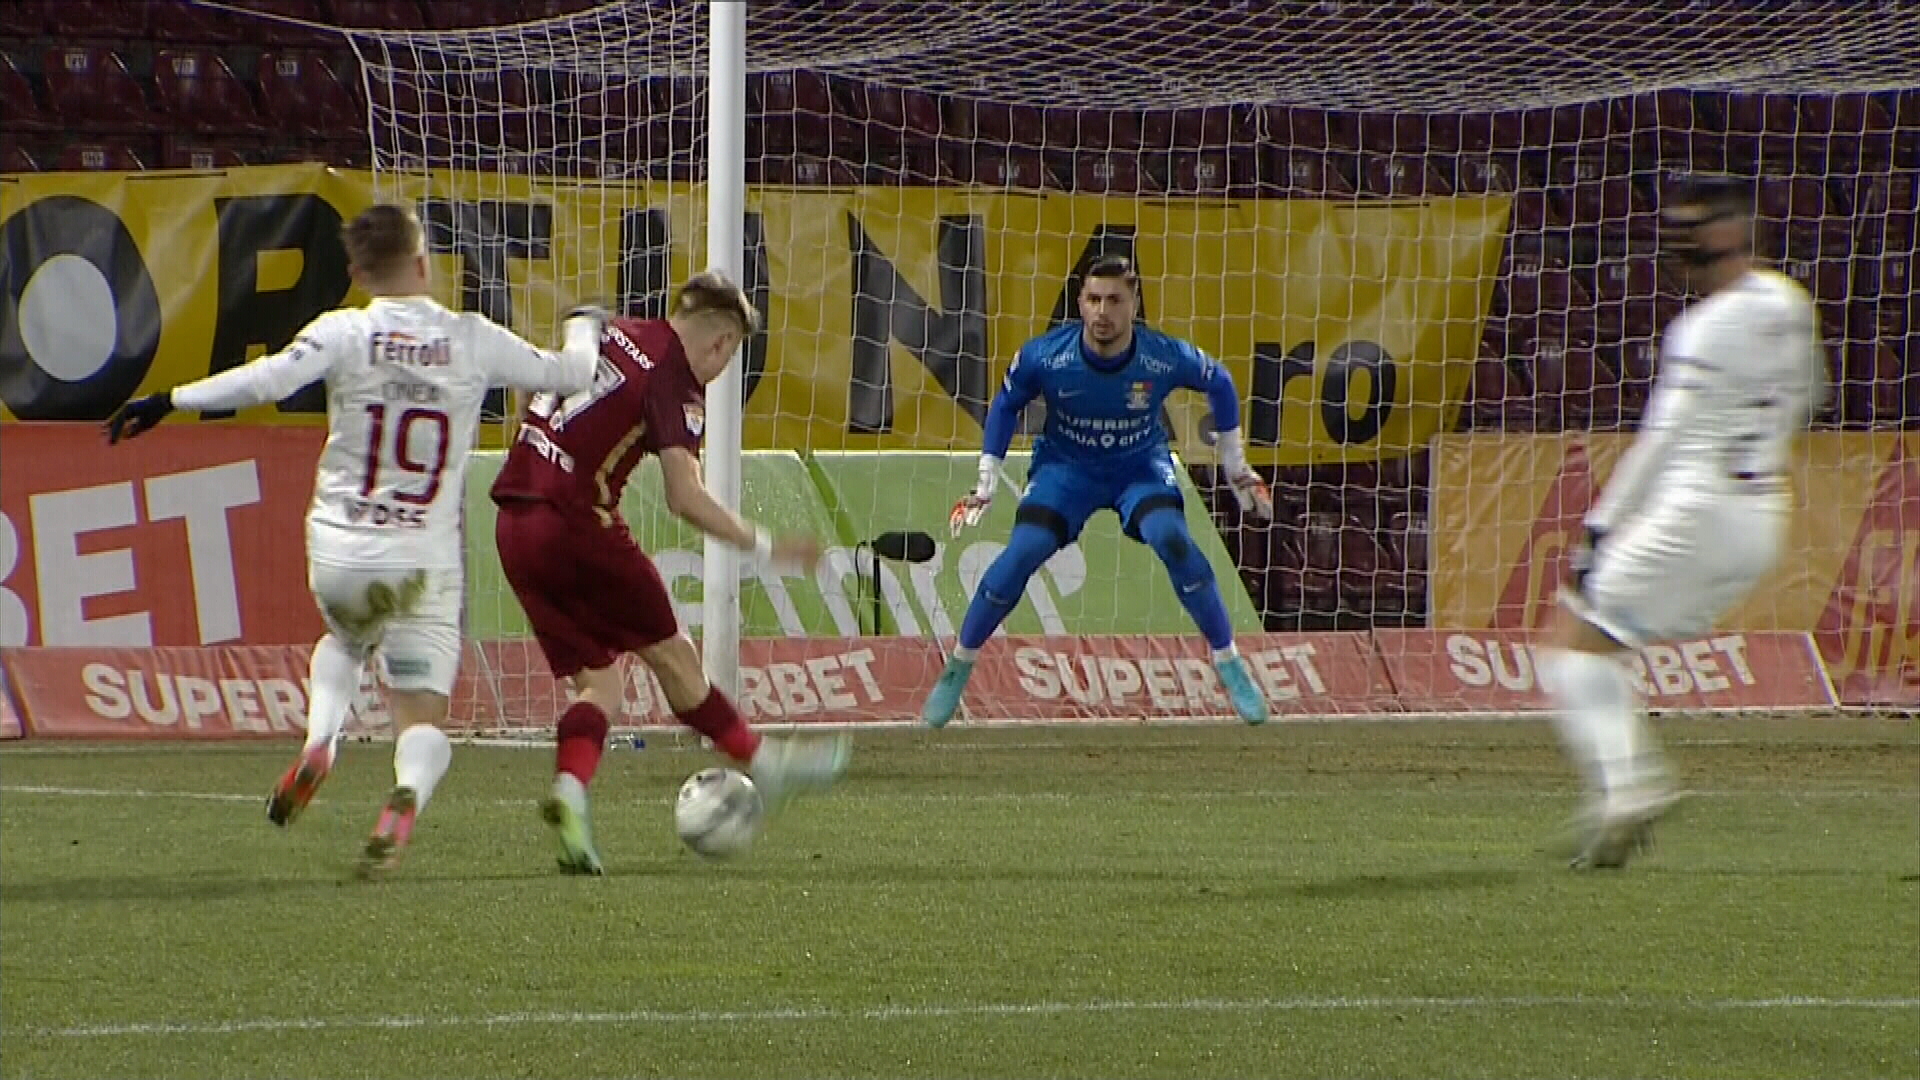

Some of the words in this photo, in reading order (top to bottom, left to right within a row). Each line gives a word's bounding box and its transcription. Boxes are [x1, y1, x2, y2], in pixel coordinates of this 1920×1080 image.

[1056, 408, 1151, 431] SUPERBET
[1118, 427, 1151, 446] CITY
[360, 402, 449, 505] 19
[1014, 641, 1327, 711] SUPERET
